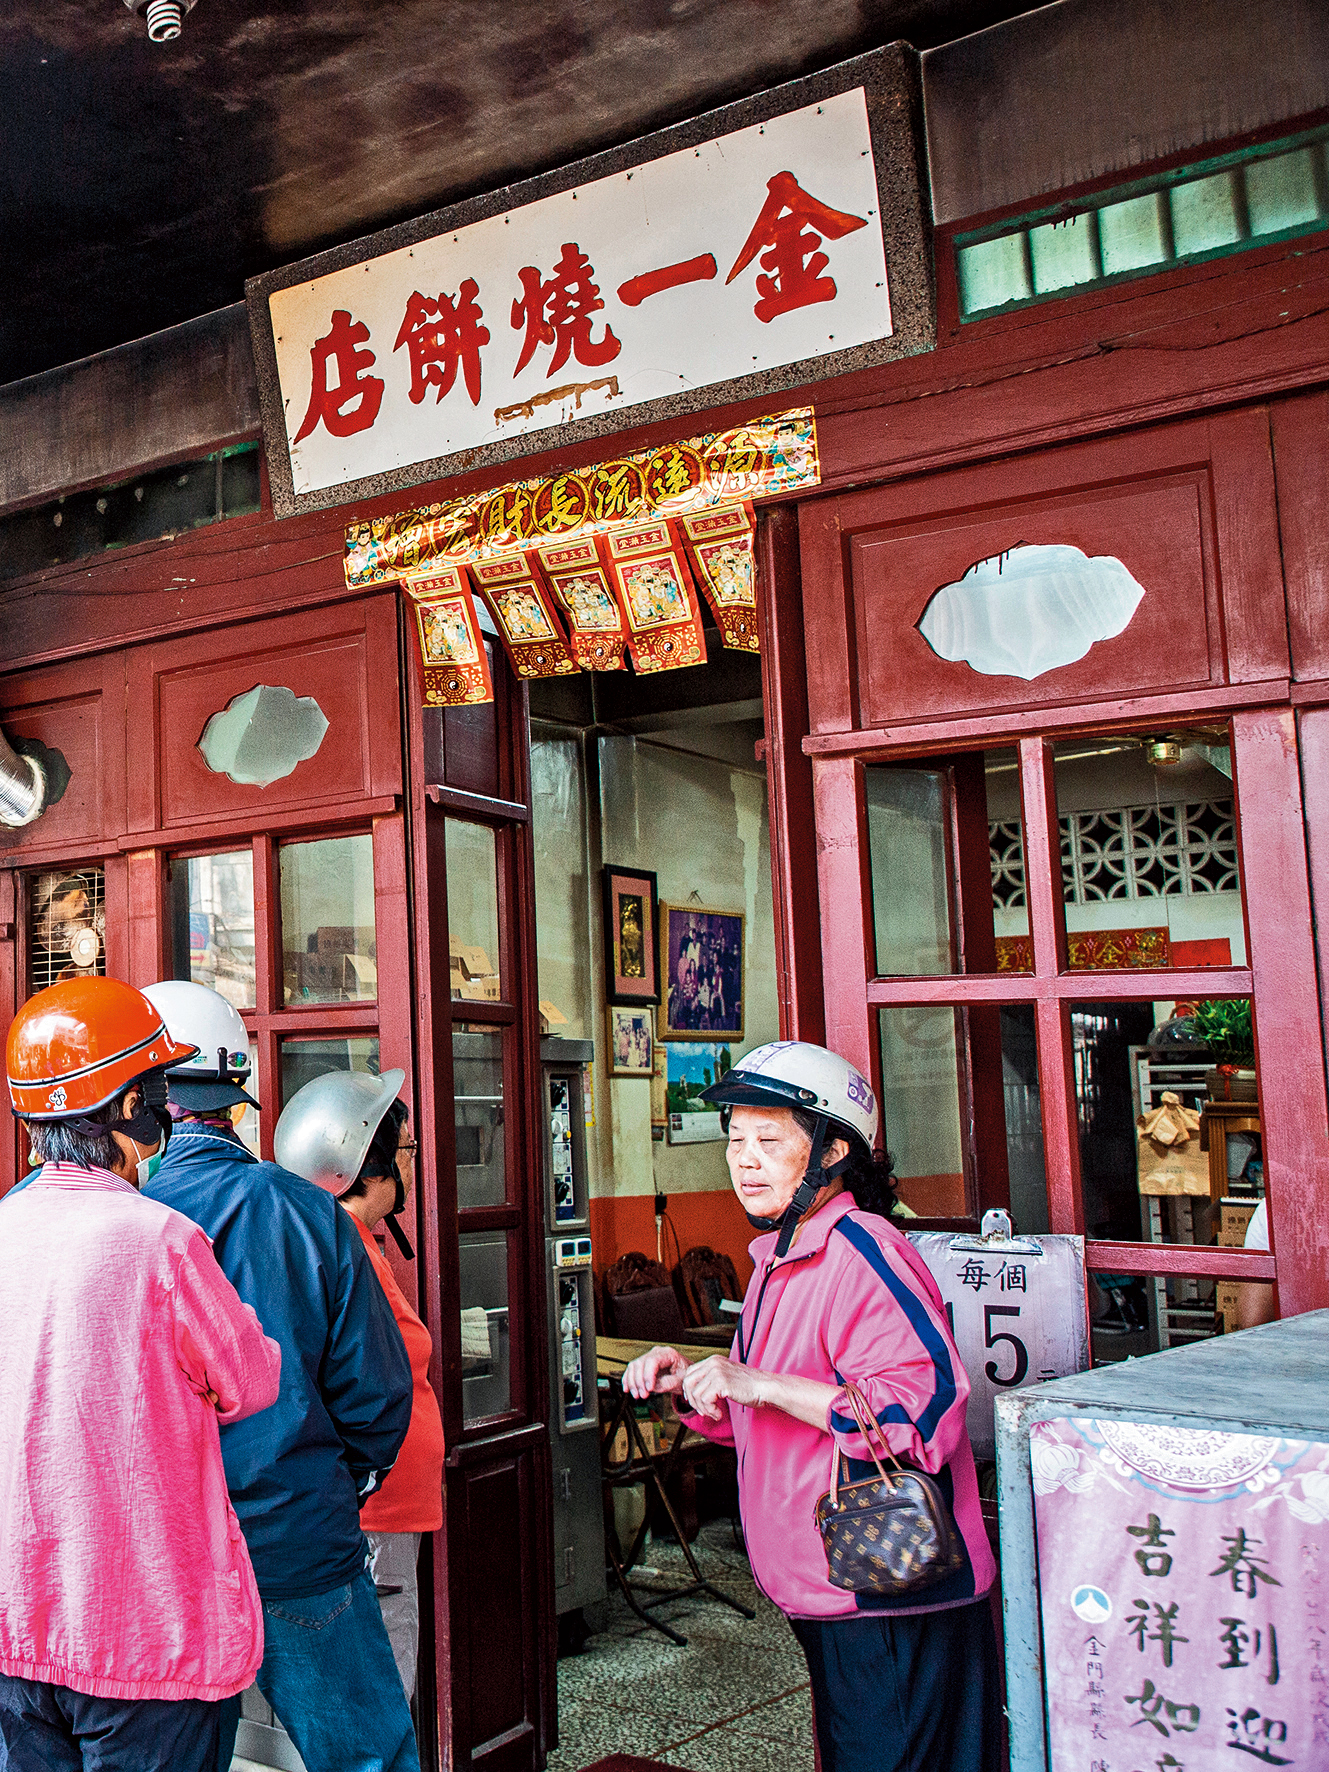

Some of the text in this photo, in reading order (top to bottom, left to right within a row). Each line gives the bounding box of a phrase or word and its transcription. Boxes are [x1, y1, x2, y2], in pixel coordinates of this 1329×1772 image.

[292, 170, 869, 445] 金一燒餅店
[956, 1257, 1027, 1293] 每個
